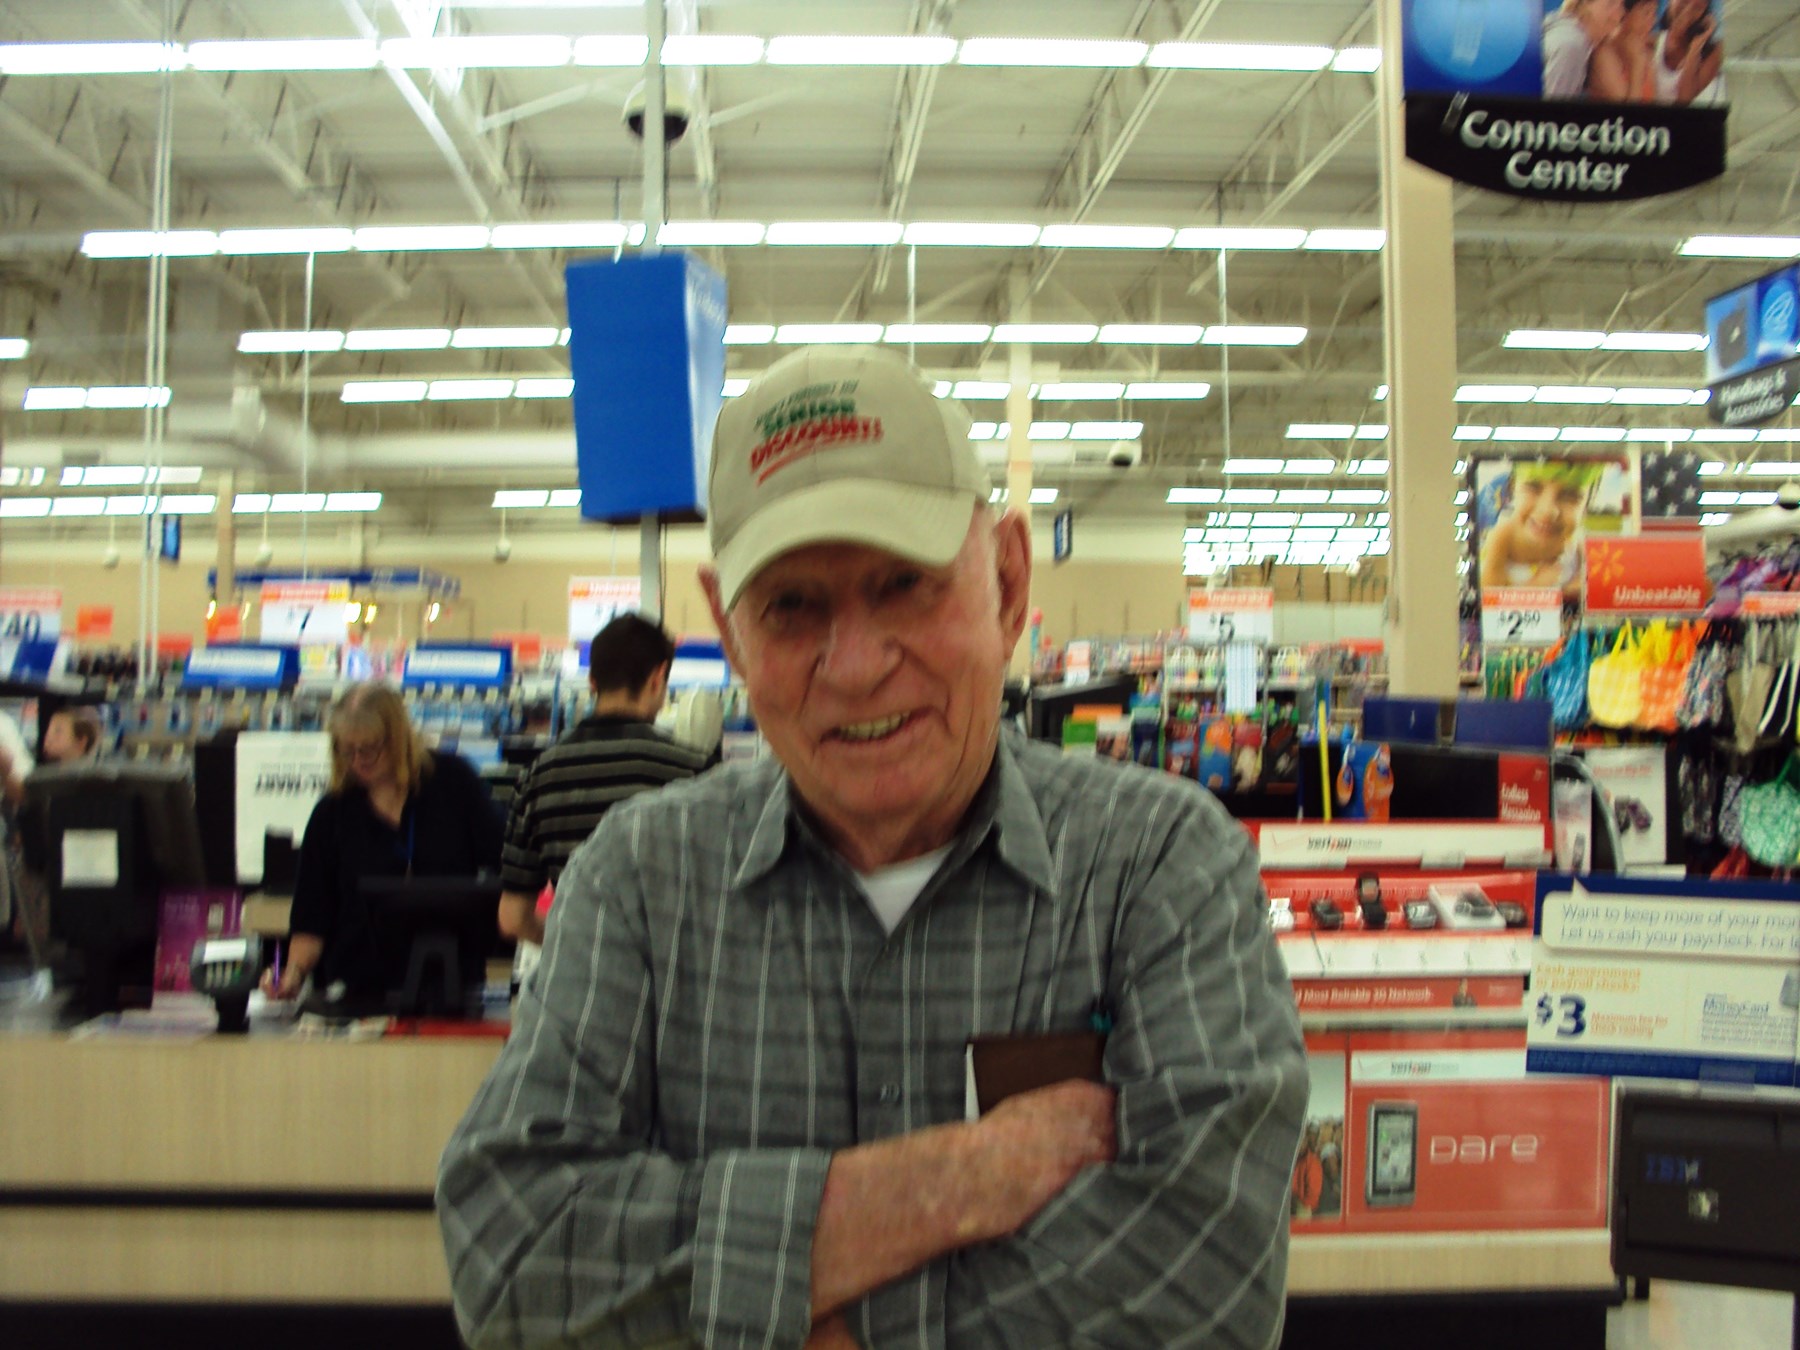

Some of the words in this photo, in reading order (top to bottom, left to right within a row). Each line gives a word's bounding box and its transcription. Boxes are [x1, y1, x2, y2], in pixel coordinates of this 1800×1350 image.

[1461, 110, 1671, 155] Connection
[1505, 151, 1629, 192] Center
[1614, 585, 1701, 607] Unbeatable
[1307, 836, 1352, 852] verizon
[1562, 903, 1600, 922] Want
[1605, 906, 1620, 922] to
[1624, 905, 1660, 926] keep
[1664, 910, 1704, 925] more
[1707, 910, 1723, 926] of
[1728, 913, 1760, 932] your
[1561, 925, 1583, 941] Let
[1588, 929, 1605, 943] us
[1608, 926, 1641, 945] cash
[1646, 930, 1678, 950] your
